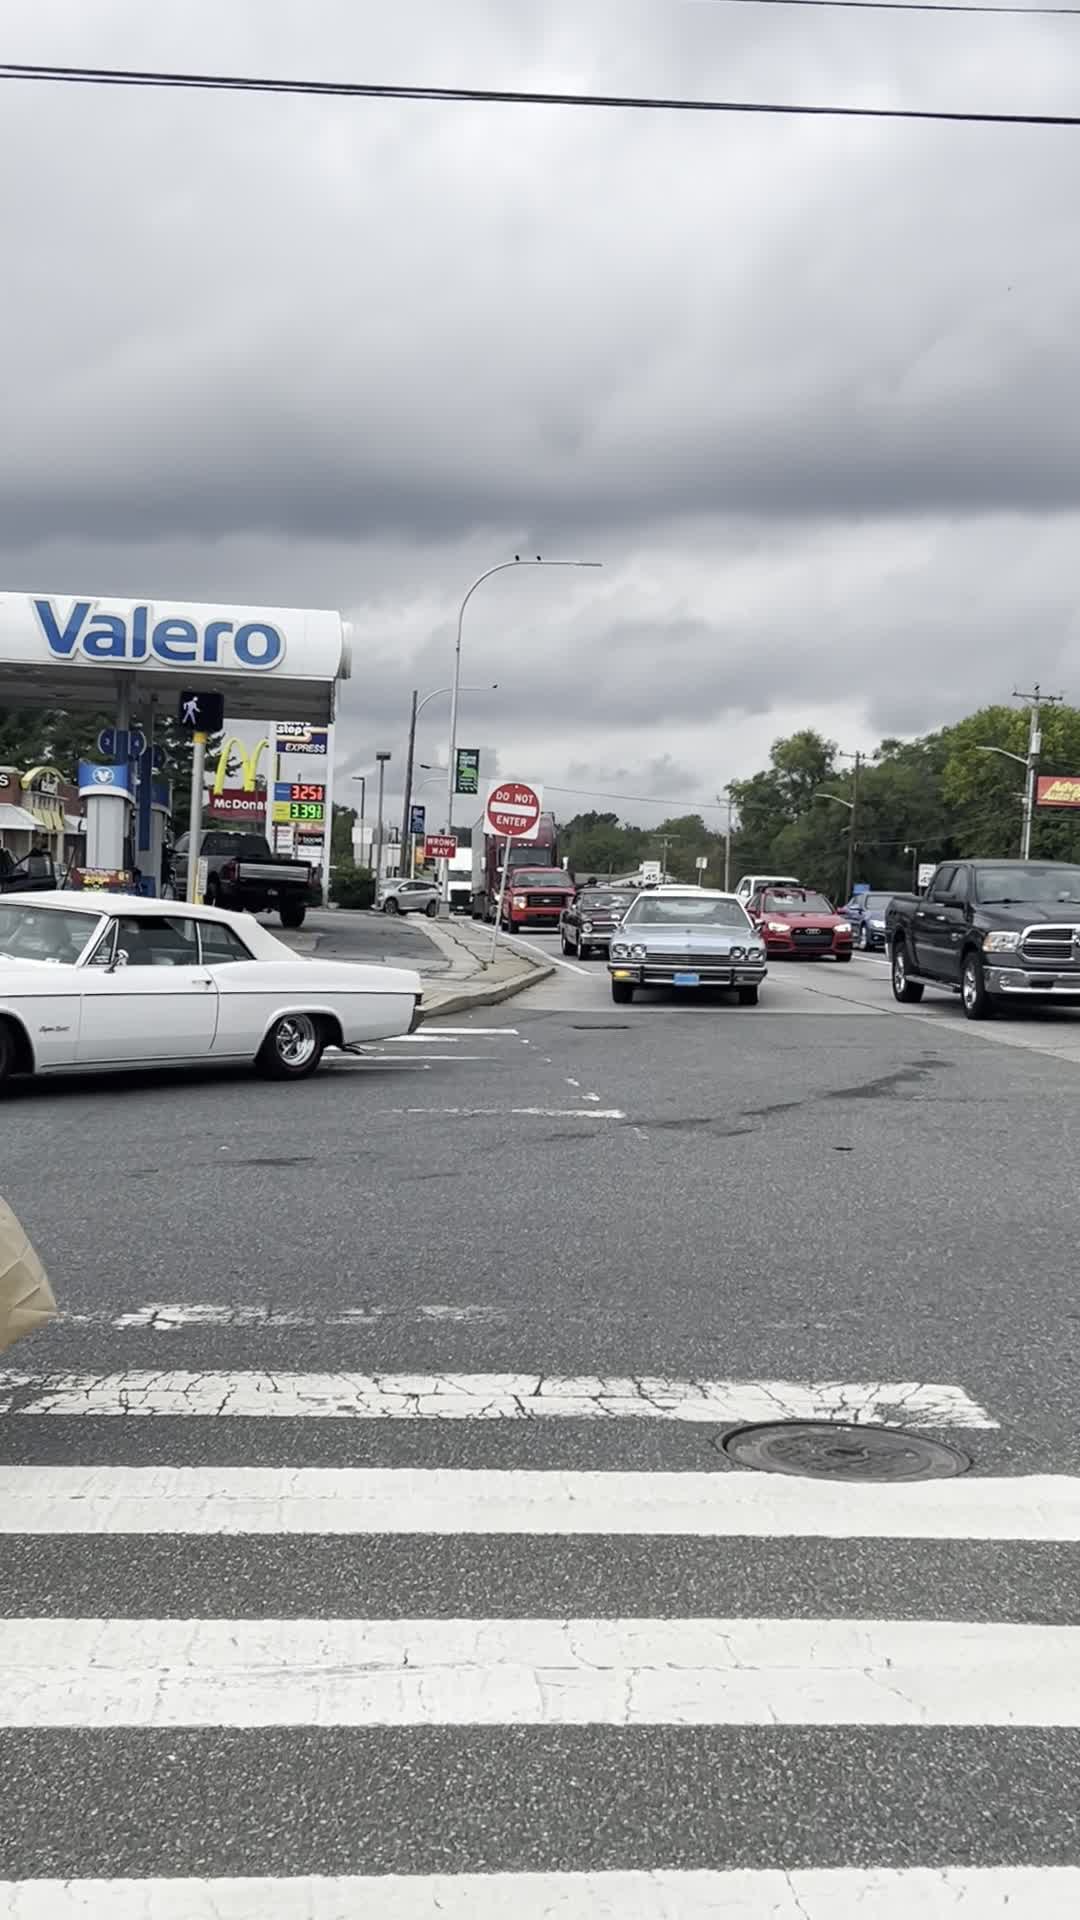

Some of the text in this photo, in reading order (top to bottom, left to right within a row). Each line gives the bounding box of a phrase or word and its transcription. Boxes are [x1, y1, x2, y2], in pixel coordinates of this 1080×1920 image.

[33, 599, 281, 666] Valero
[285, 742, 326, 754] EXPRESS
[496, 790, 534, 804] DO NOT
[496, 815, 528, 828] ENTER
[427, 837, 456, 848] WRONG
[431, 847, 449, 856] WAY
